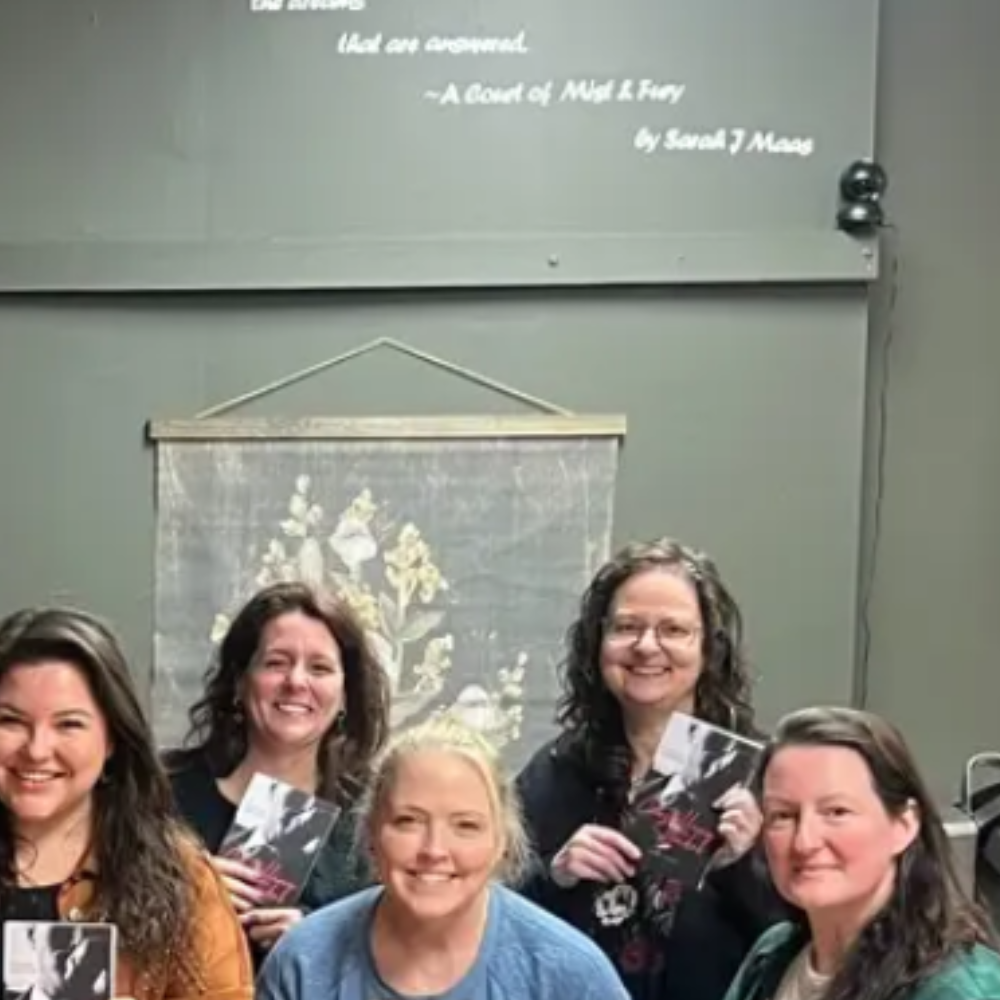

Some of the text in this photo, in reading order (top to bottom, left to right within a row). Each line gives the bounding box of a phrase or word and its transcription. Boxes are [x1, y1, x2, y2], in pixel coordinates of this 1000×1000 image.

[337, 32, 382, 54] that
[384, 37, 420, 54] are
[464, 83, 523, 104] Court
[527, 81, 552, 106] of
[560, 79, 614, 103] Mist
[617, 79, 633, 101] &
[637, 79, 685, 104] Fury
[663, 128, 726, 150] Sarah
[729, 128, 746, 155] J
[746, 131, 814, 157] Maas
